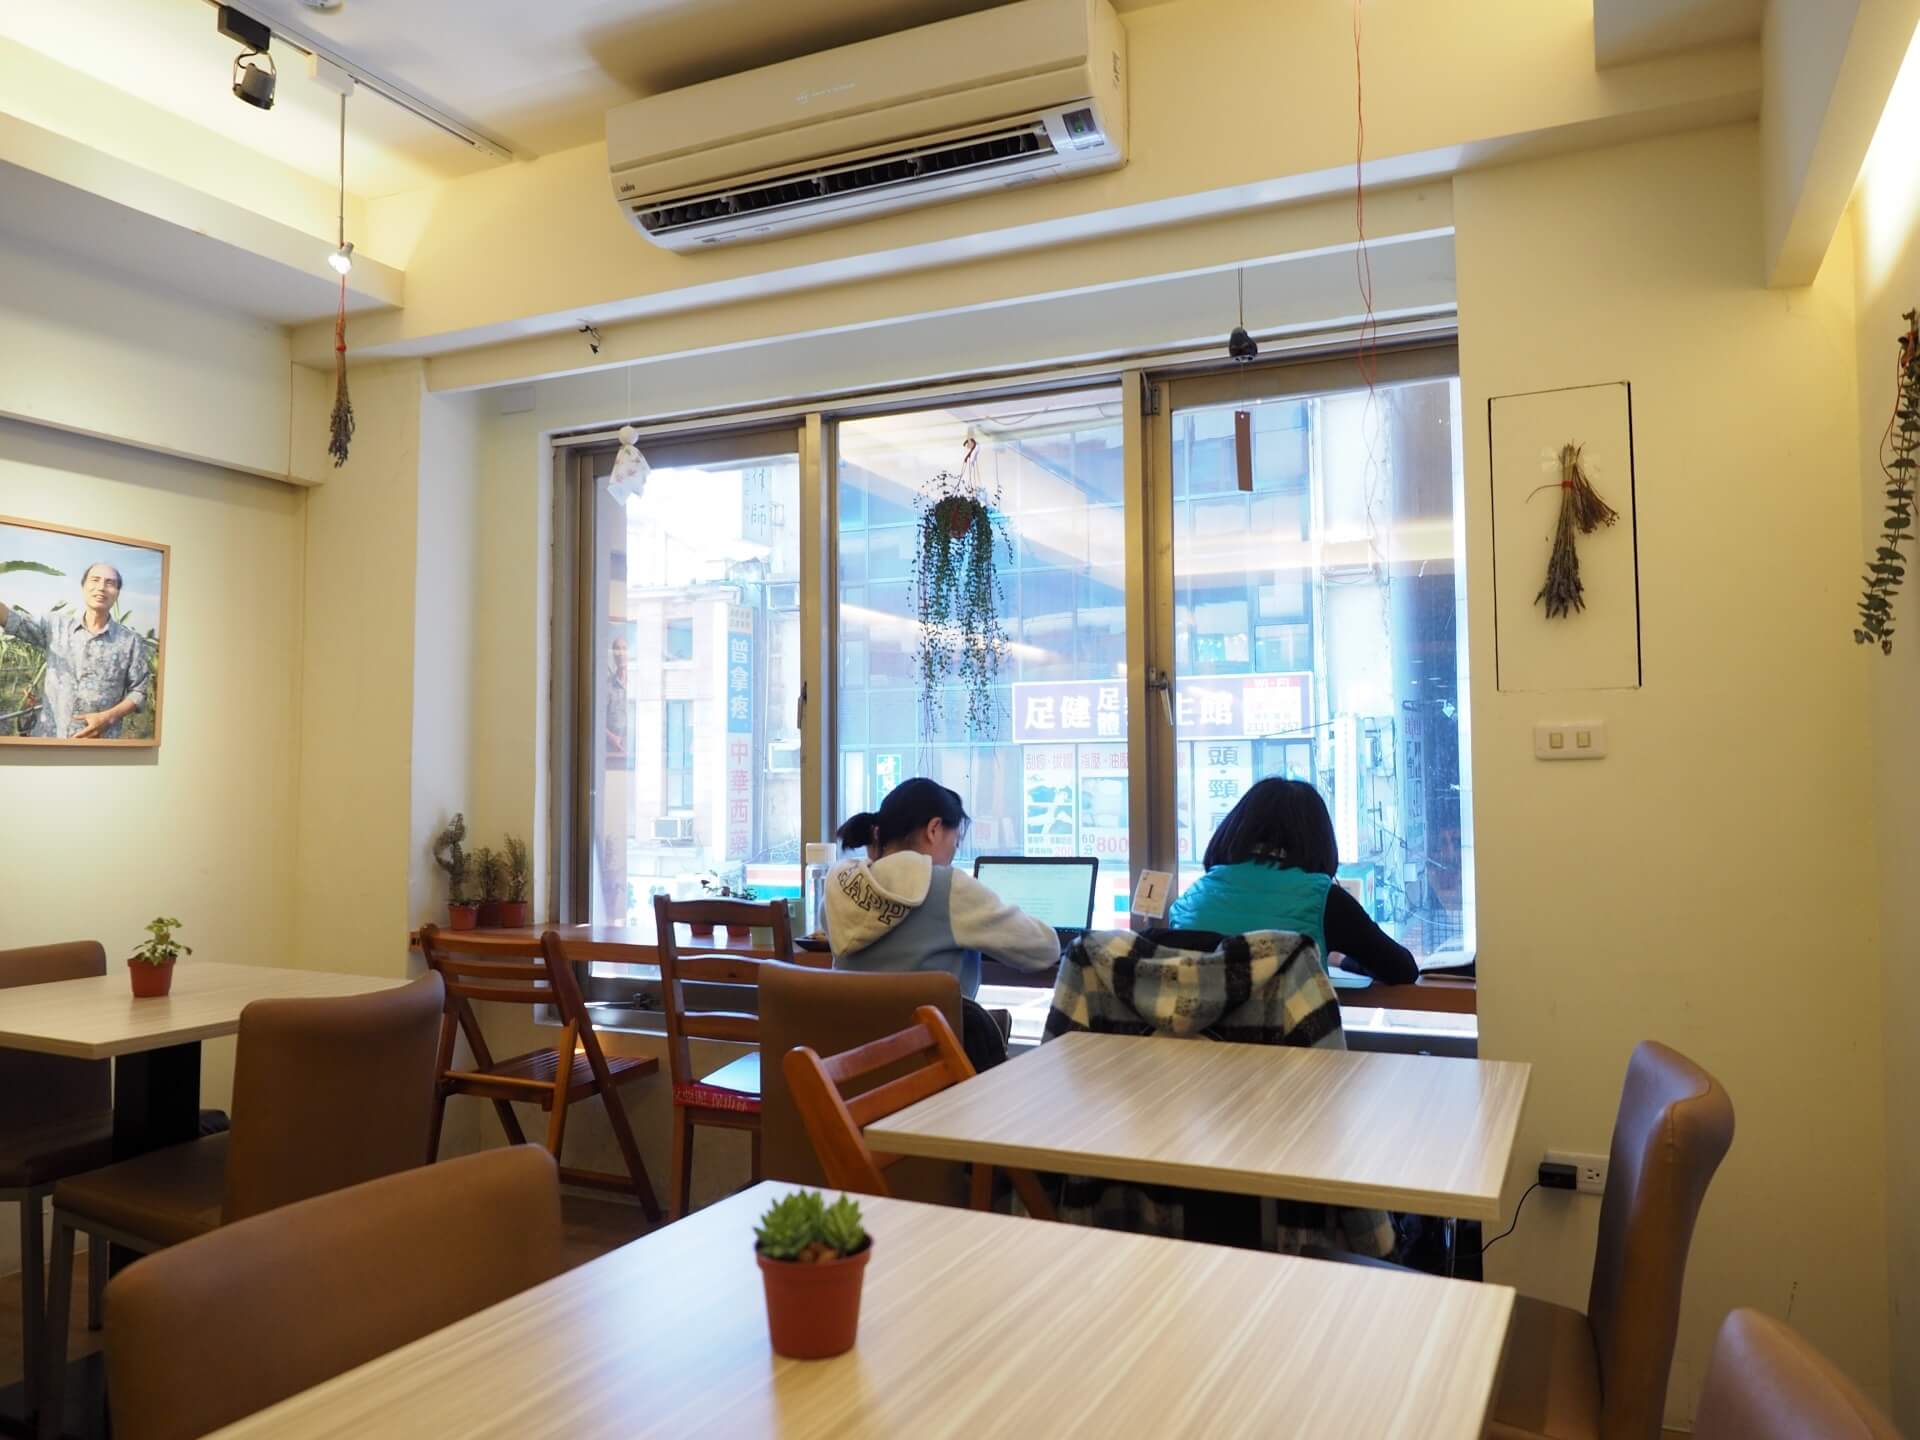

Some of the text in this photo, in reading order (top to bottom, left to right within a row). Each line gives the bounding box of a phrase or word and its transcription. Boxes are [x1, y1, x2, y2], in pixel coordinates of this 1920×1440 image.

[1024, 695, 1092, 730] 足健
[729, 738, 750, 855] 中華西藥
[838, 863, 912, 925] APP
